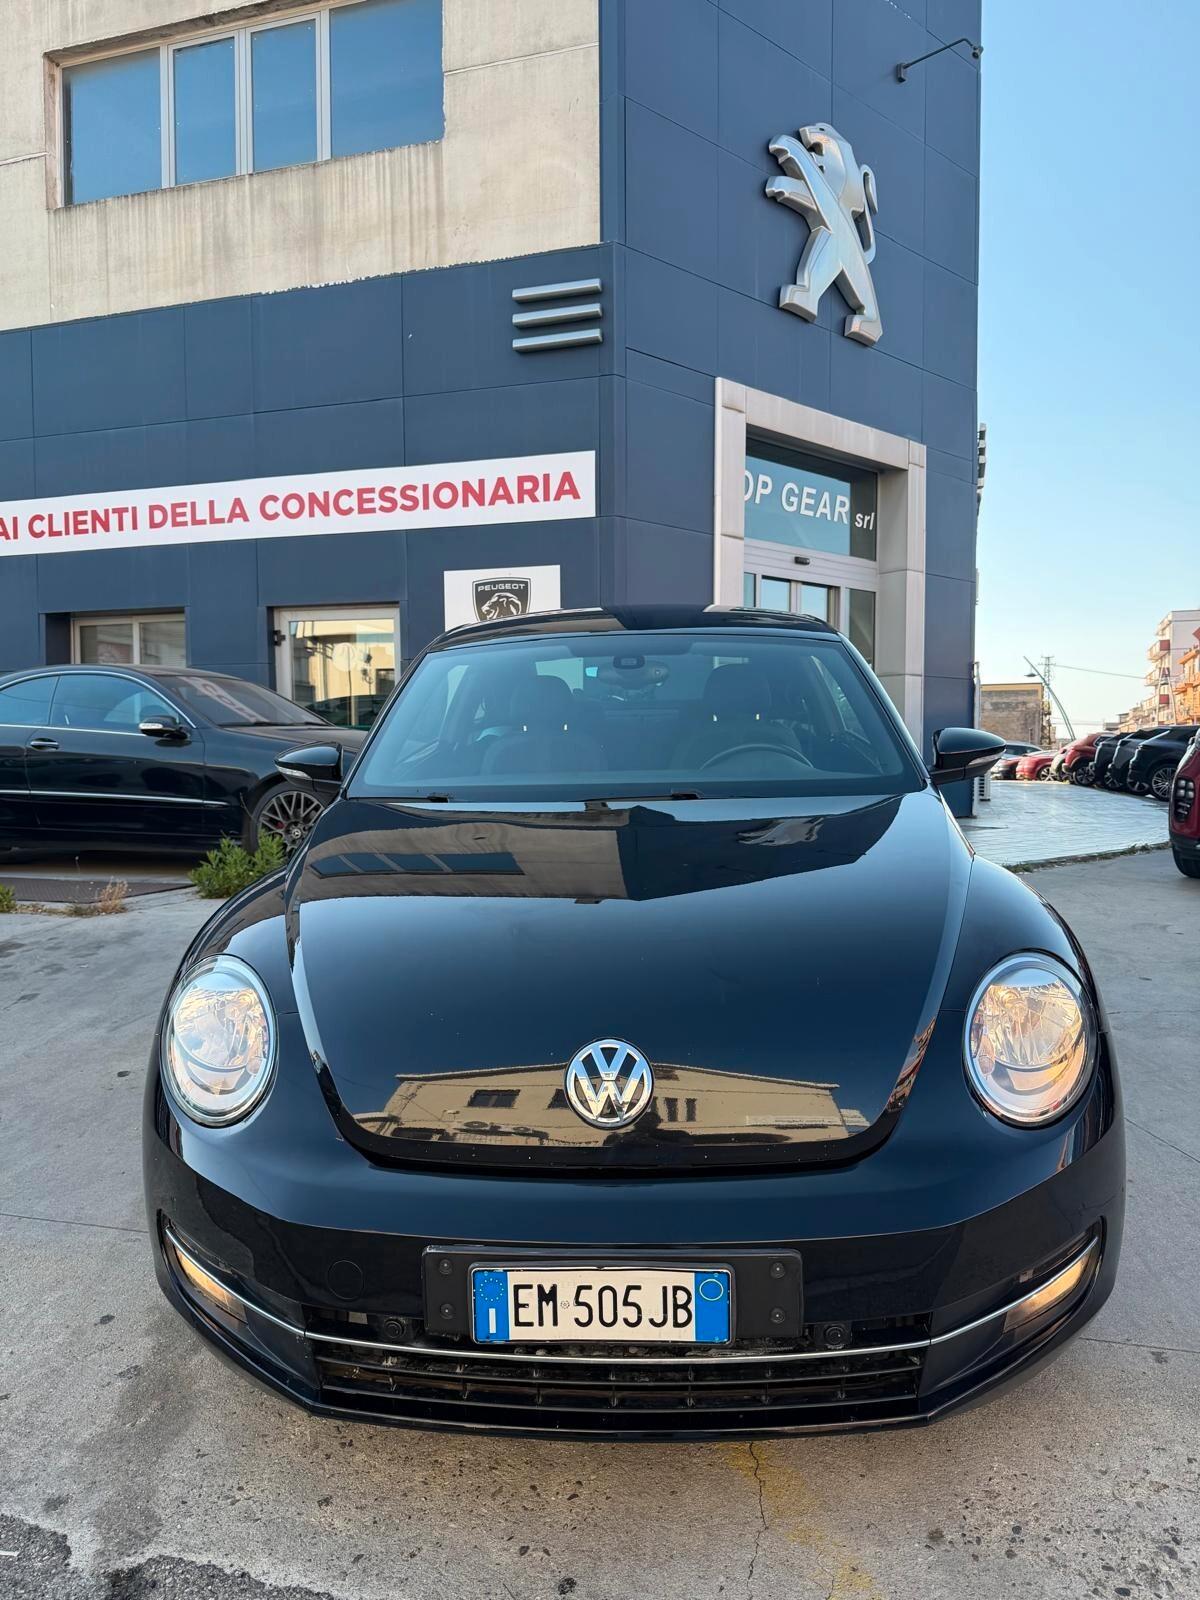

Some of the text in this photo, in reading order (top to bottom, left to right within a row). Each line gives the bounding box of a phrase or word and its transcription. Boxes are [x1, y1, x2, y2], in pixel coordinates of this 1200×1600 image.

[28, 506, 138, 539] CLIENTI
[148, 497, 250, 529] DELLA
[259, 471, 581, 521] CONCESSIONARIA
[781, 482, 850, 524] GEAR
[854, 512, 875, 530] srl
[477, 583, 526, 592] PEUGEOT
[513, 1284, 558, 1327] EM
